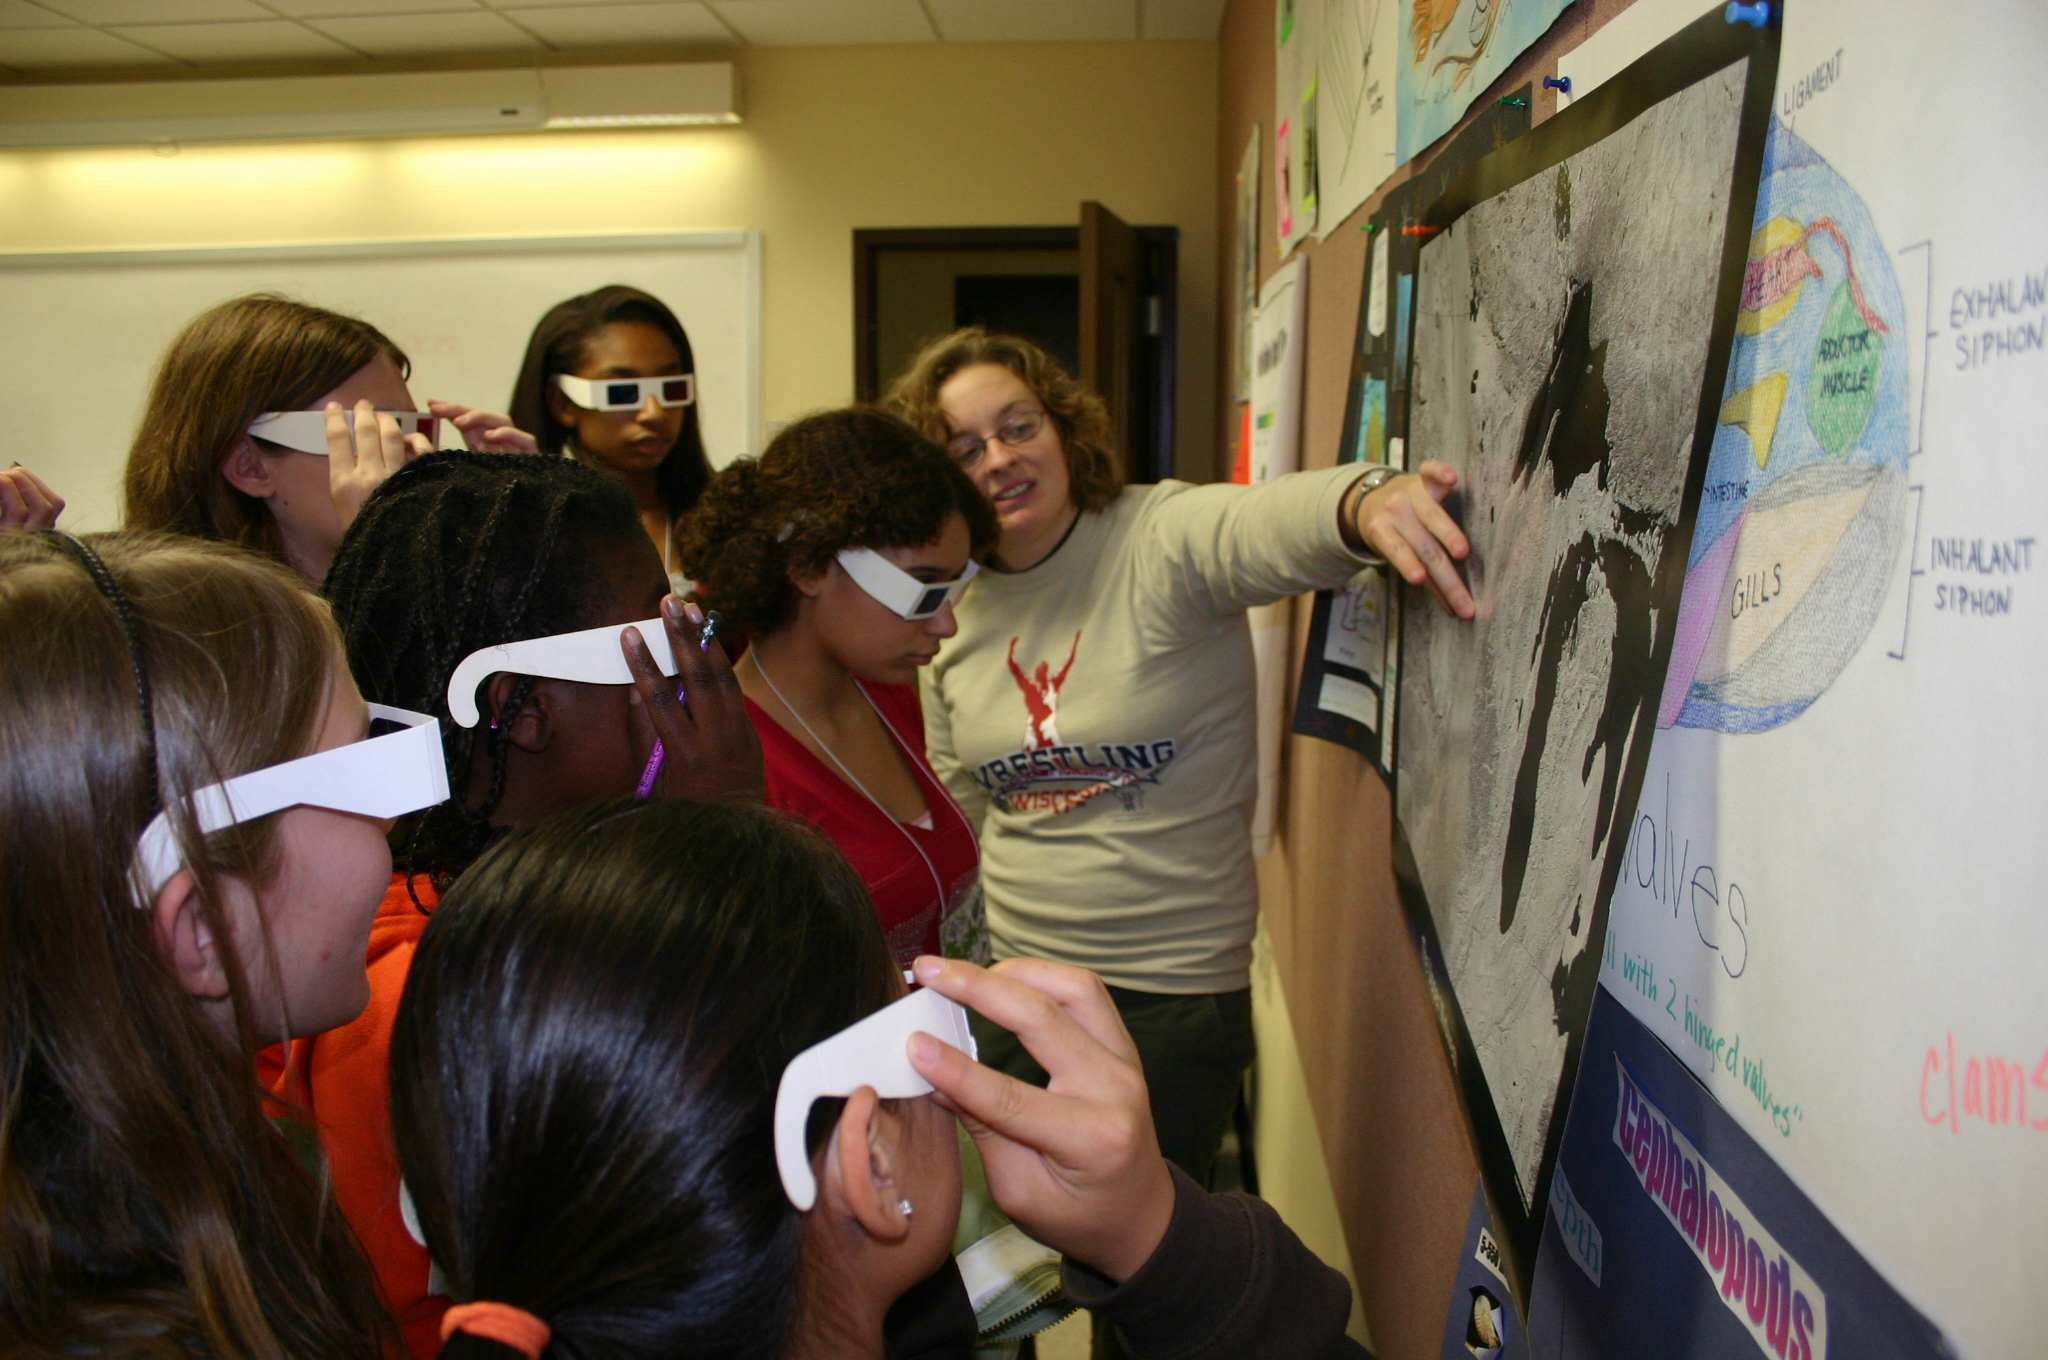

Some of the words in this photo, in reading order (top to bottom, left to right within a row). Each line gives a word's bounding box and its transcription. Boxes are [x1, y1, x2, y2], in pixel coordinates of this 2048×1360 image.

[1783, 48, 1843, 116] LIGAMENT
[1955, 313, 2047, 371] SIPHON
[1821, 367, 1868, 399] MUSCLE
[1931, 535, 2036, 576] INHALANT
[1730, 562, 1782, 620] GILLS
[1935, 585, 2013, 617] SIPHON
[1624, 951, 1658, 1002] with
[1665, 978, 1678, 1022] 2
[1684, 993, 1740, 1079] hinged
